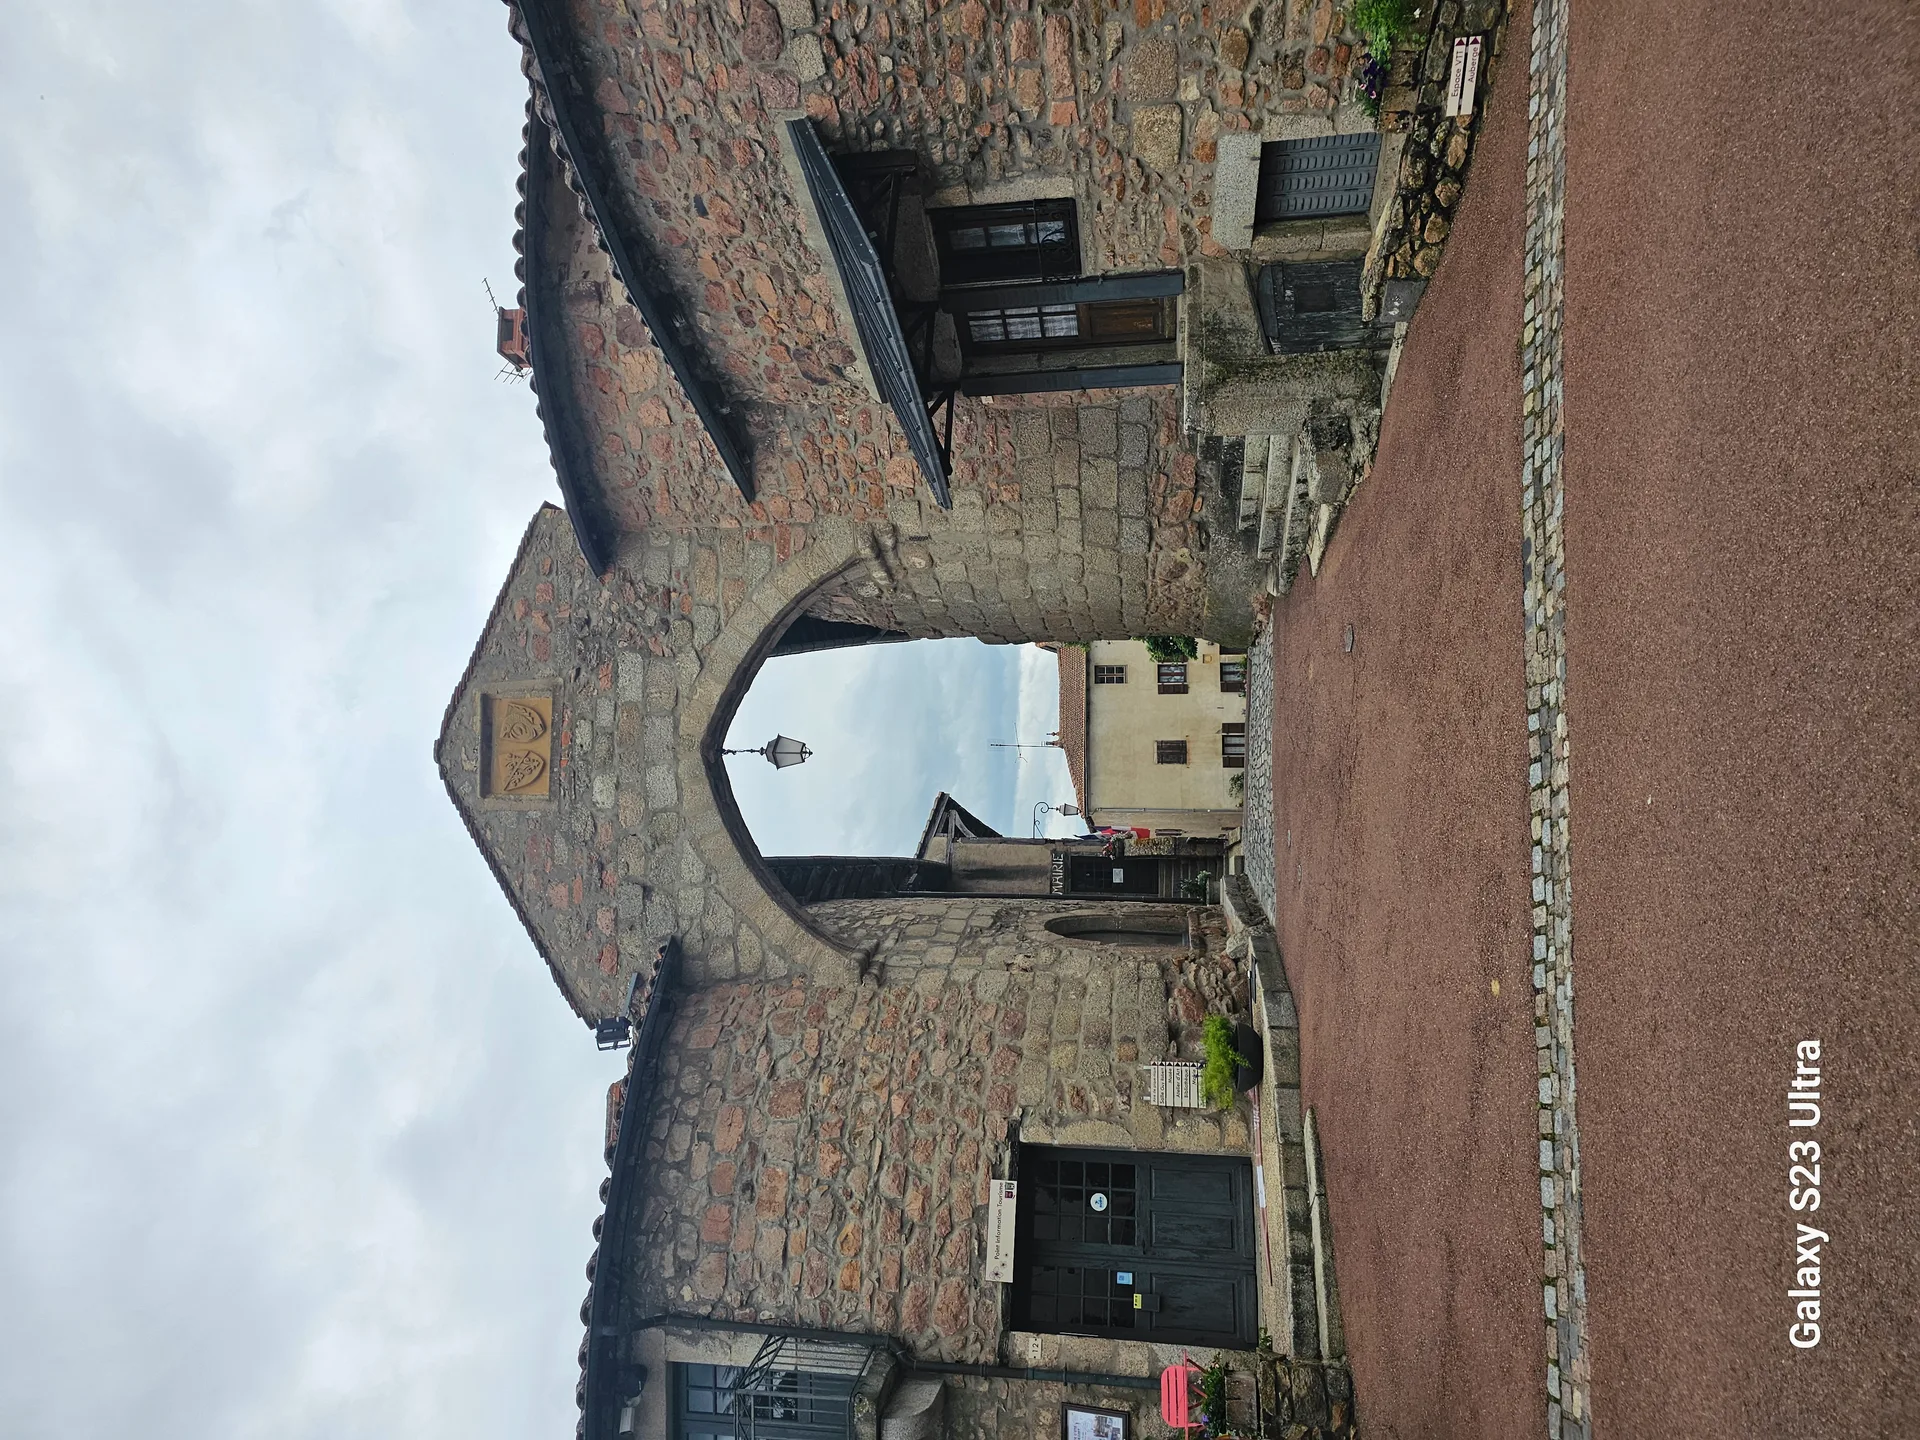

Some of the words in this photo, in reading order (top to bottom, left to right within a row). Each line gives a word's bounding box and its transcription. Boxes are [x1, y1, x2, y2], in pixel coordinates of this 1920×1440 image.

[1455, 51, 1463, 66] VTT
[1468, 47, 1479, 82] Auberge
[1451, 68, 1462, 97] Espace
[1052, 853, 1063, 895] MAIRIE
[1032, 1343, 1038, 1352] 12
